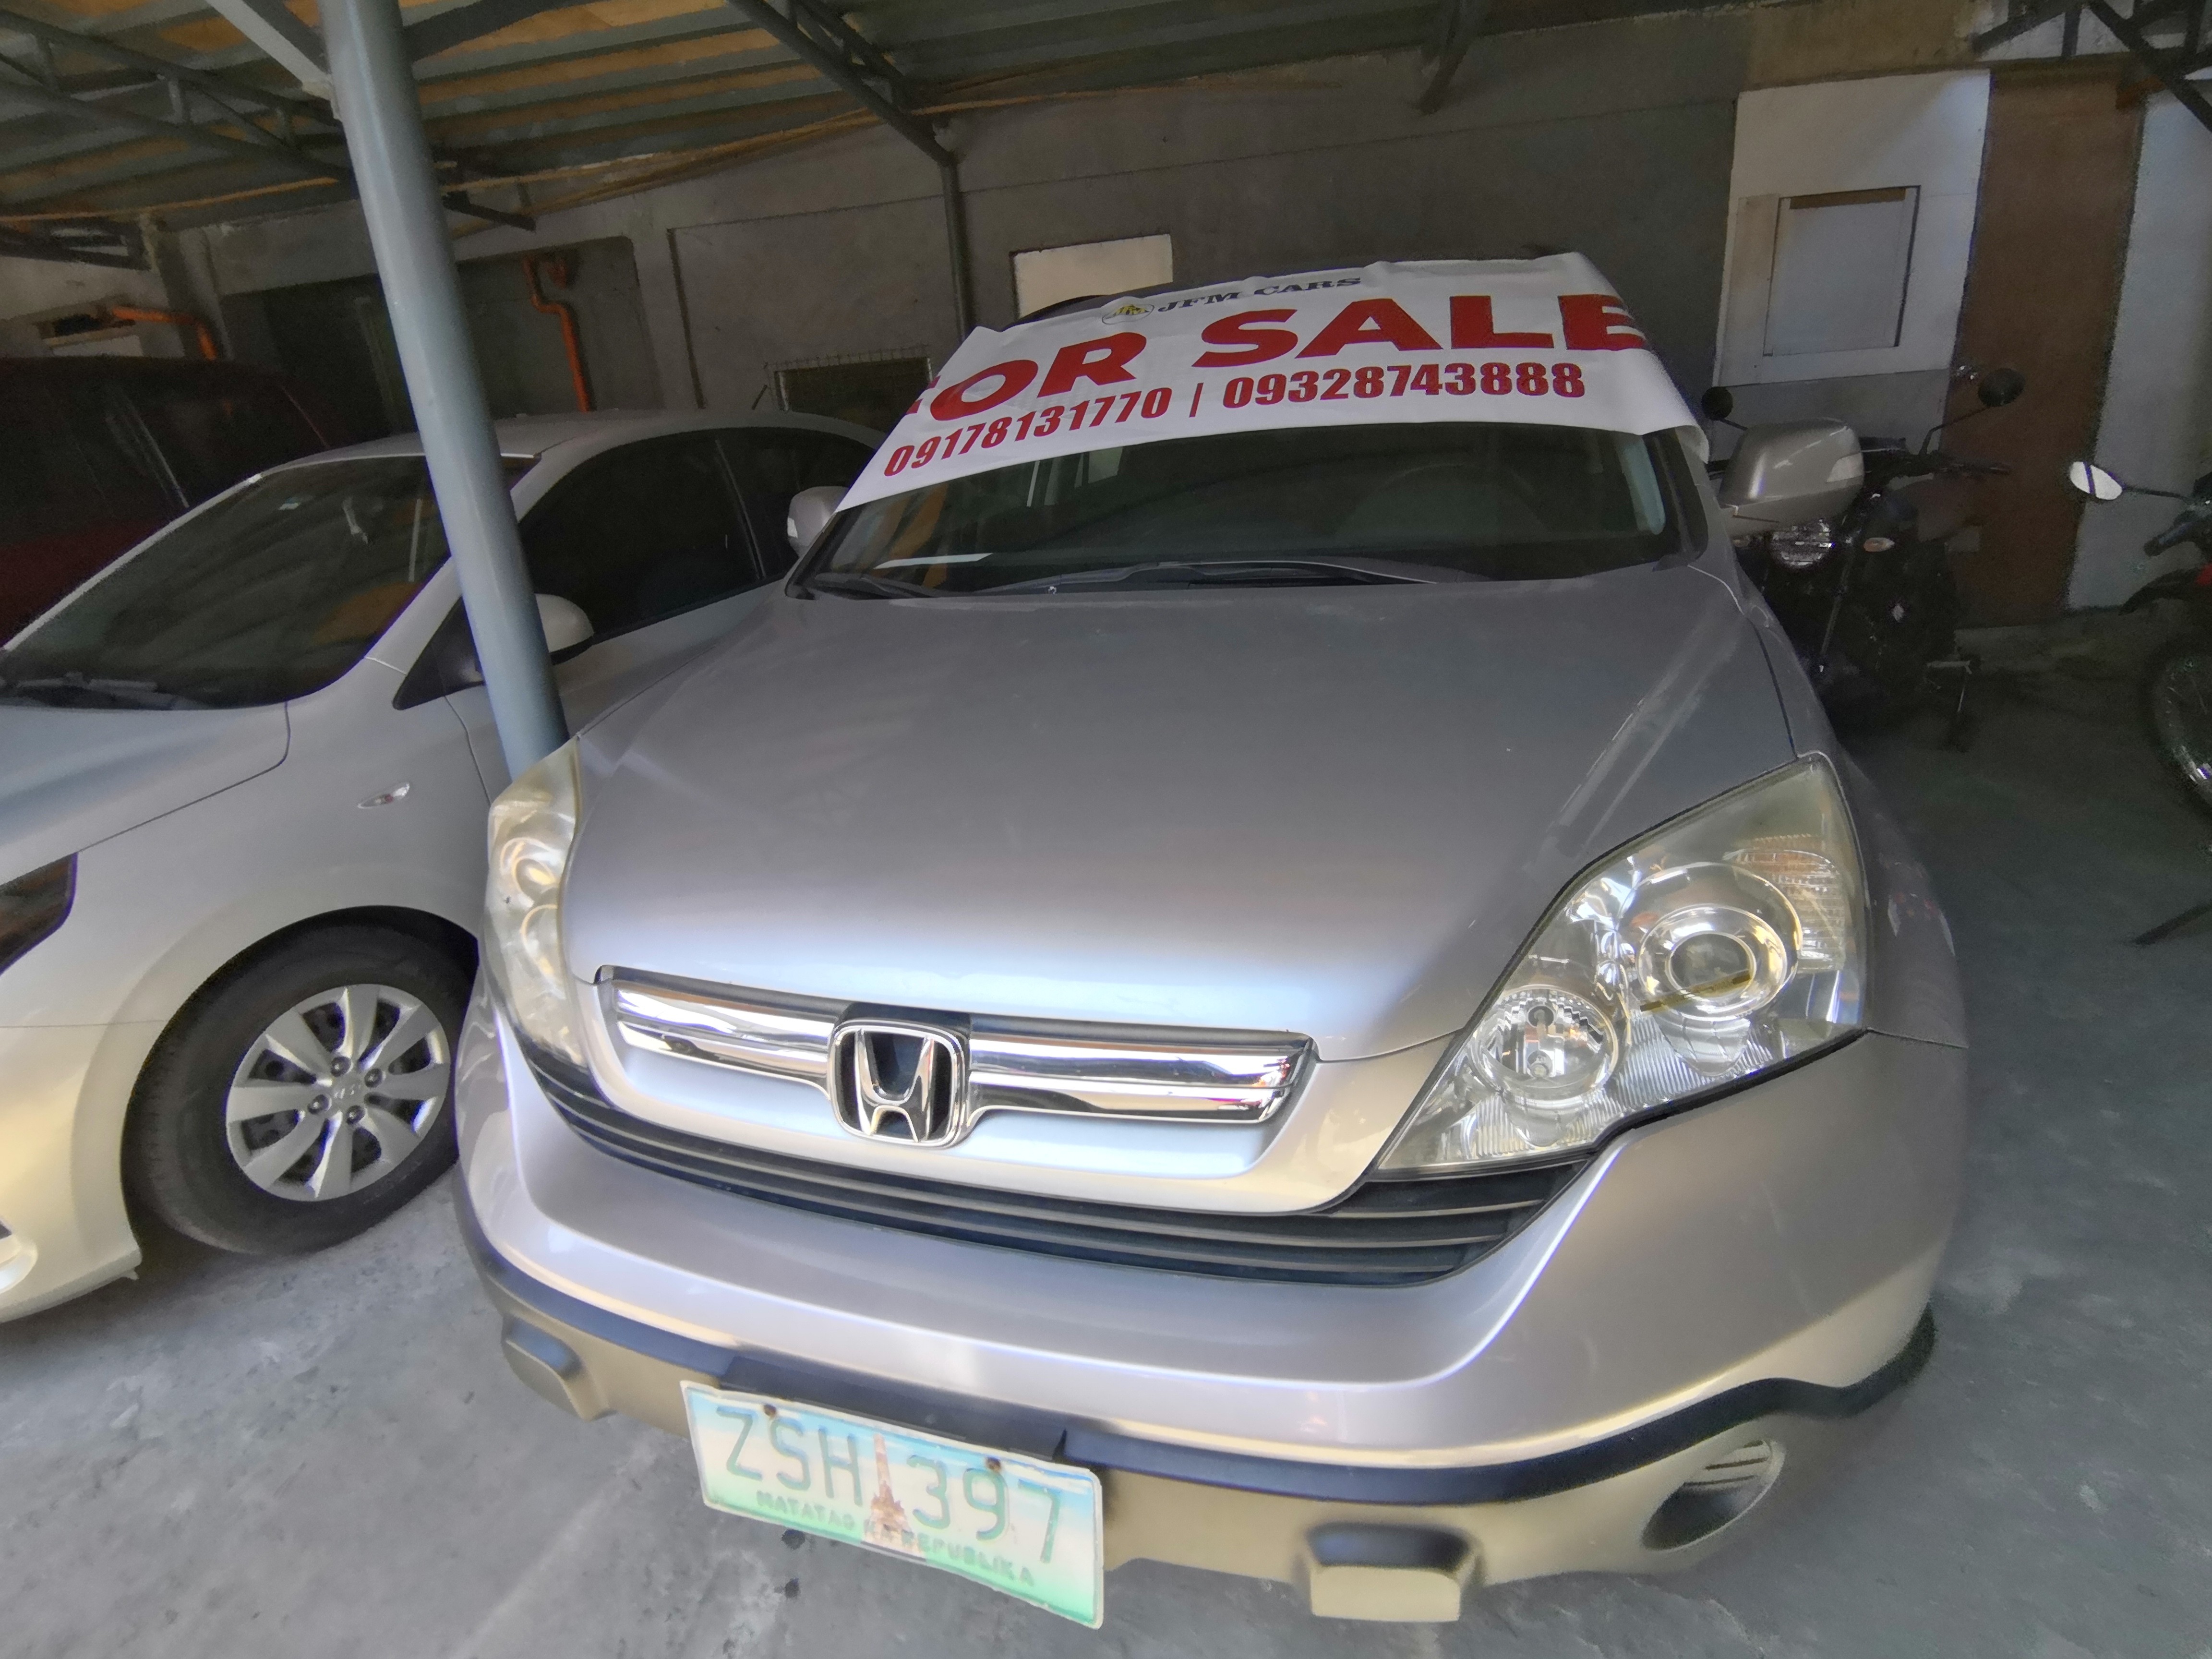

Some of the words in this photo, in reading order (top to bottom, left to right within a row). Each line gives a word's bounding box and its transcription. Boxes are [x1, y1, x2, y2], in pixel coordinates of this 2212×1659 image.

[1157, 291, 1241, 312] JFM
[1254, 277, 1361, 295] CARS
[1191, 294, 1647, 368] SALE
[884, 387, 1172, 477] 09178131770
[1222, 362, 1585, 409] 09328743888
[716, 1406, 863, 1506] ZSH
[906, 1454, 1062, 1564] 397
[901, 1528, 1034, 1587] REPUBLIKA
